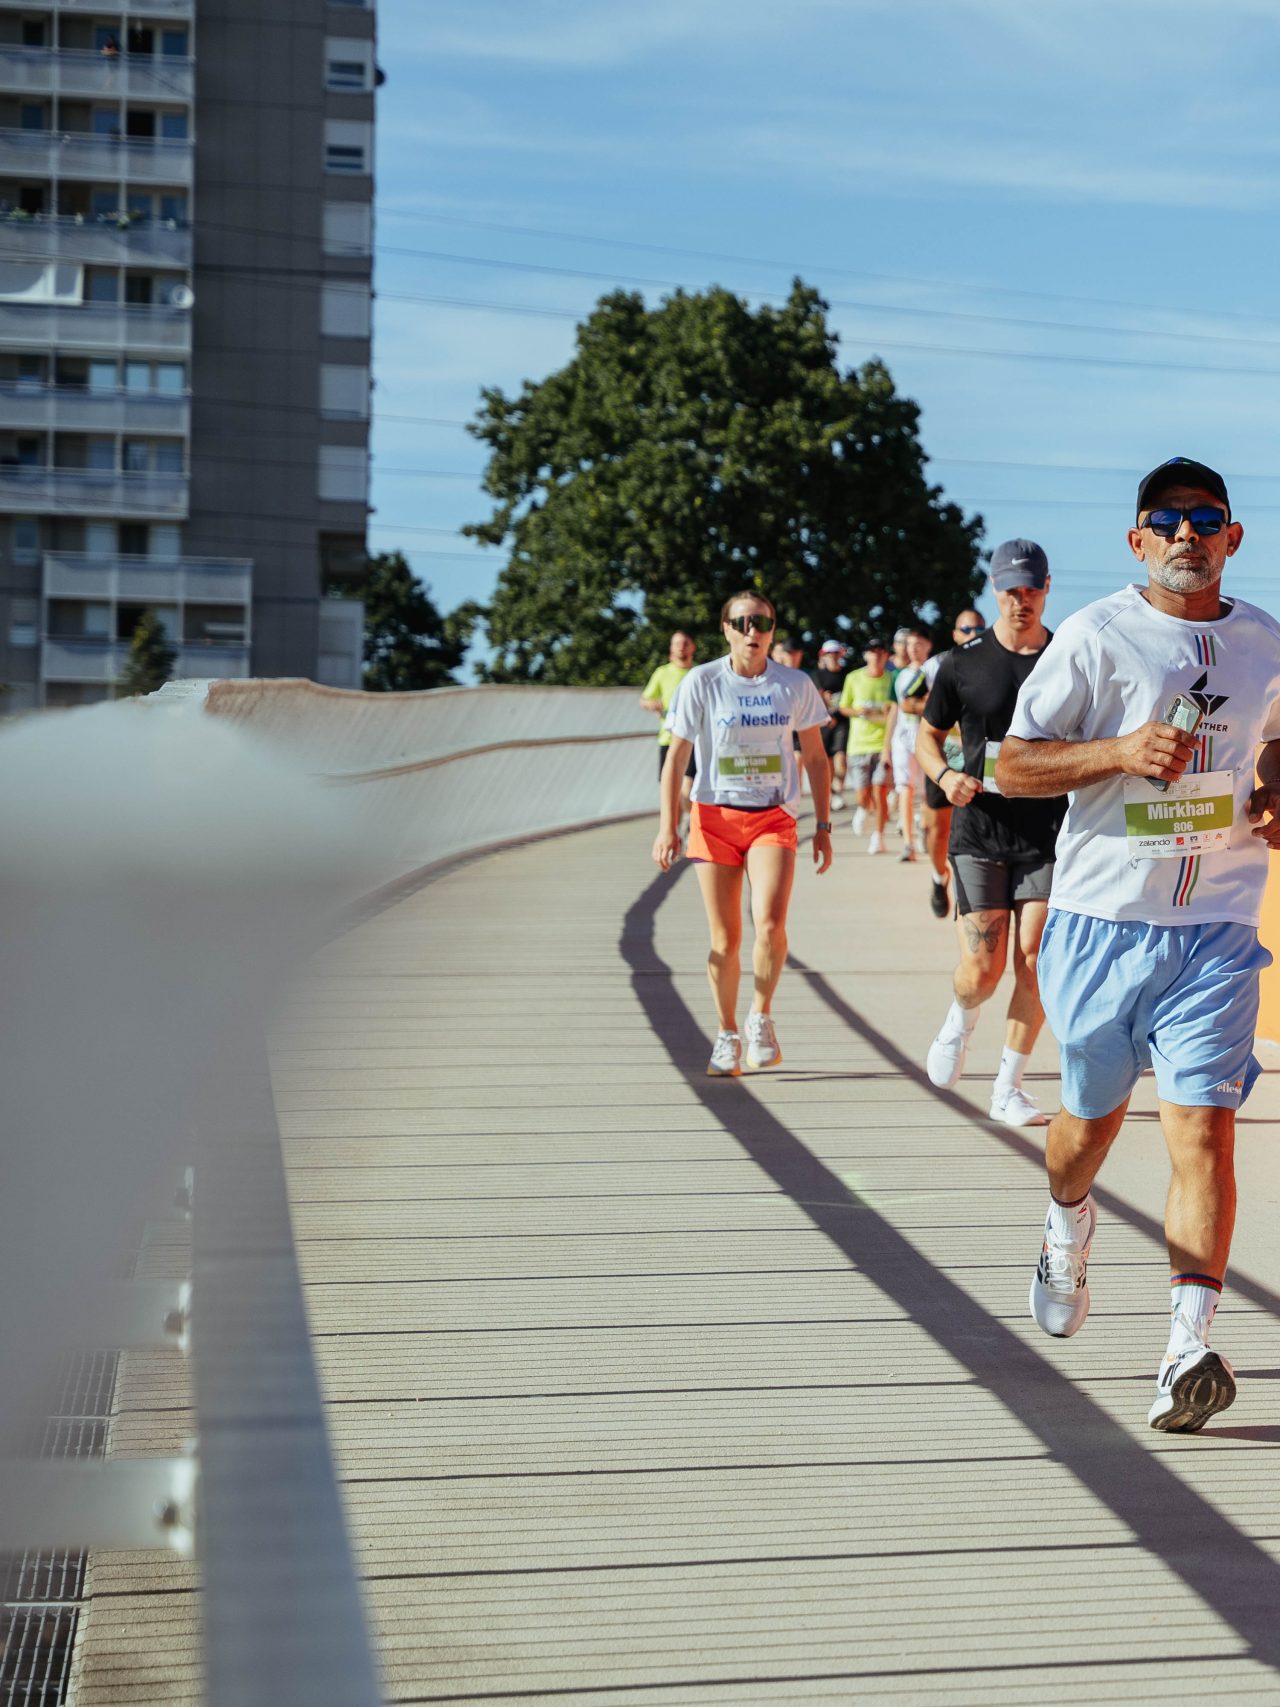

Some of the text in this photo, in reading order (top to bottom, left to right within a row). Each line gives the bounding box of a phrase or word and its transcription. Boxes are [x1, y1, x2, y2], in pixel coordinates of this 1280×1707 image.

[737, 695, 772, 707] TEAM
[741, 713, 790, 727] Nestler
[1199, 721, 1228, 732] NTHER
[1147, 801, 1215, 820] Mirkhan
[1173, 821, 1194, 833] 806
[1139, 839, 1171, 847] zalando
